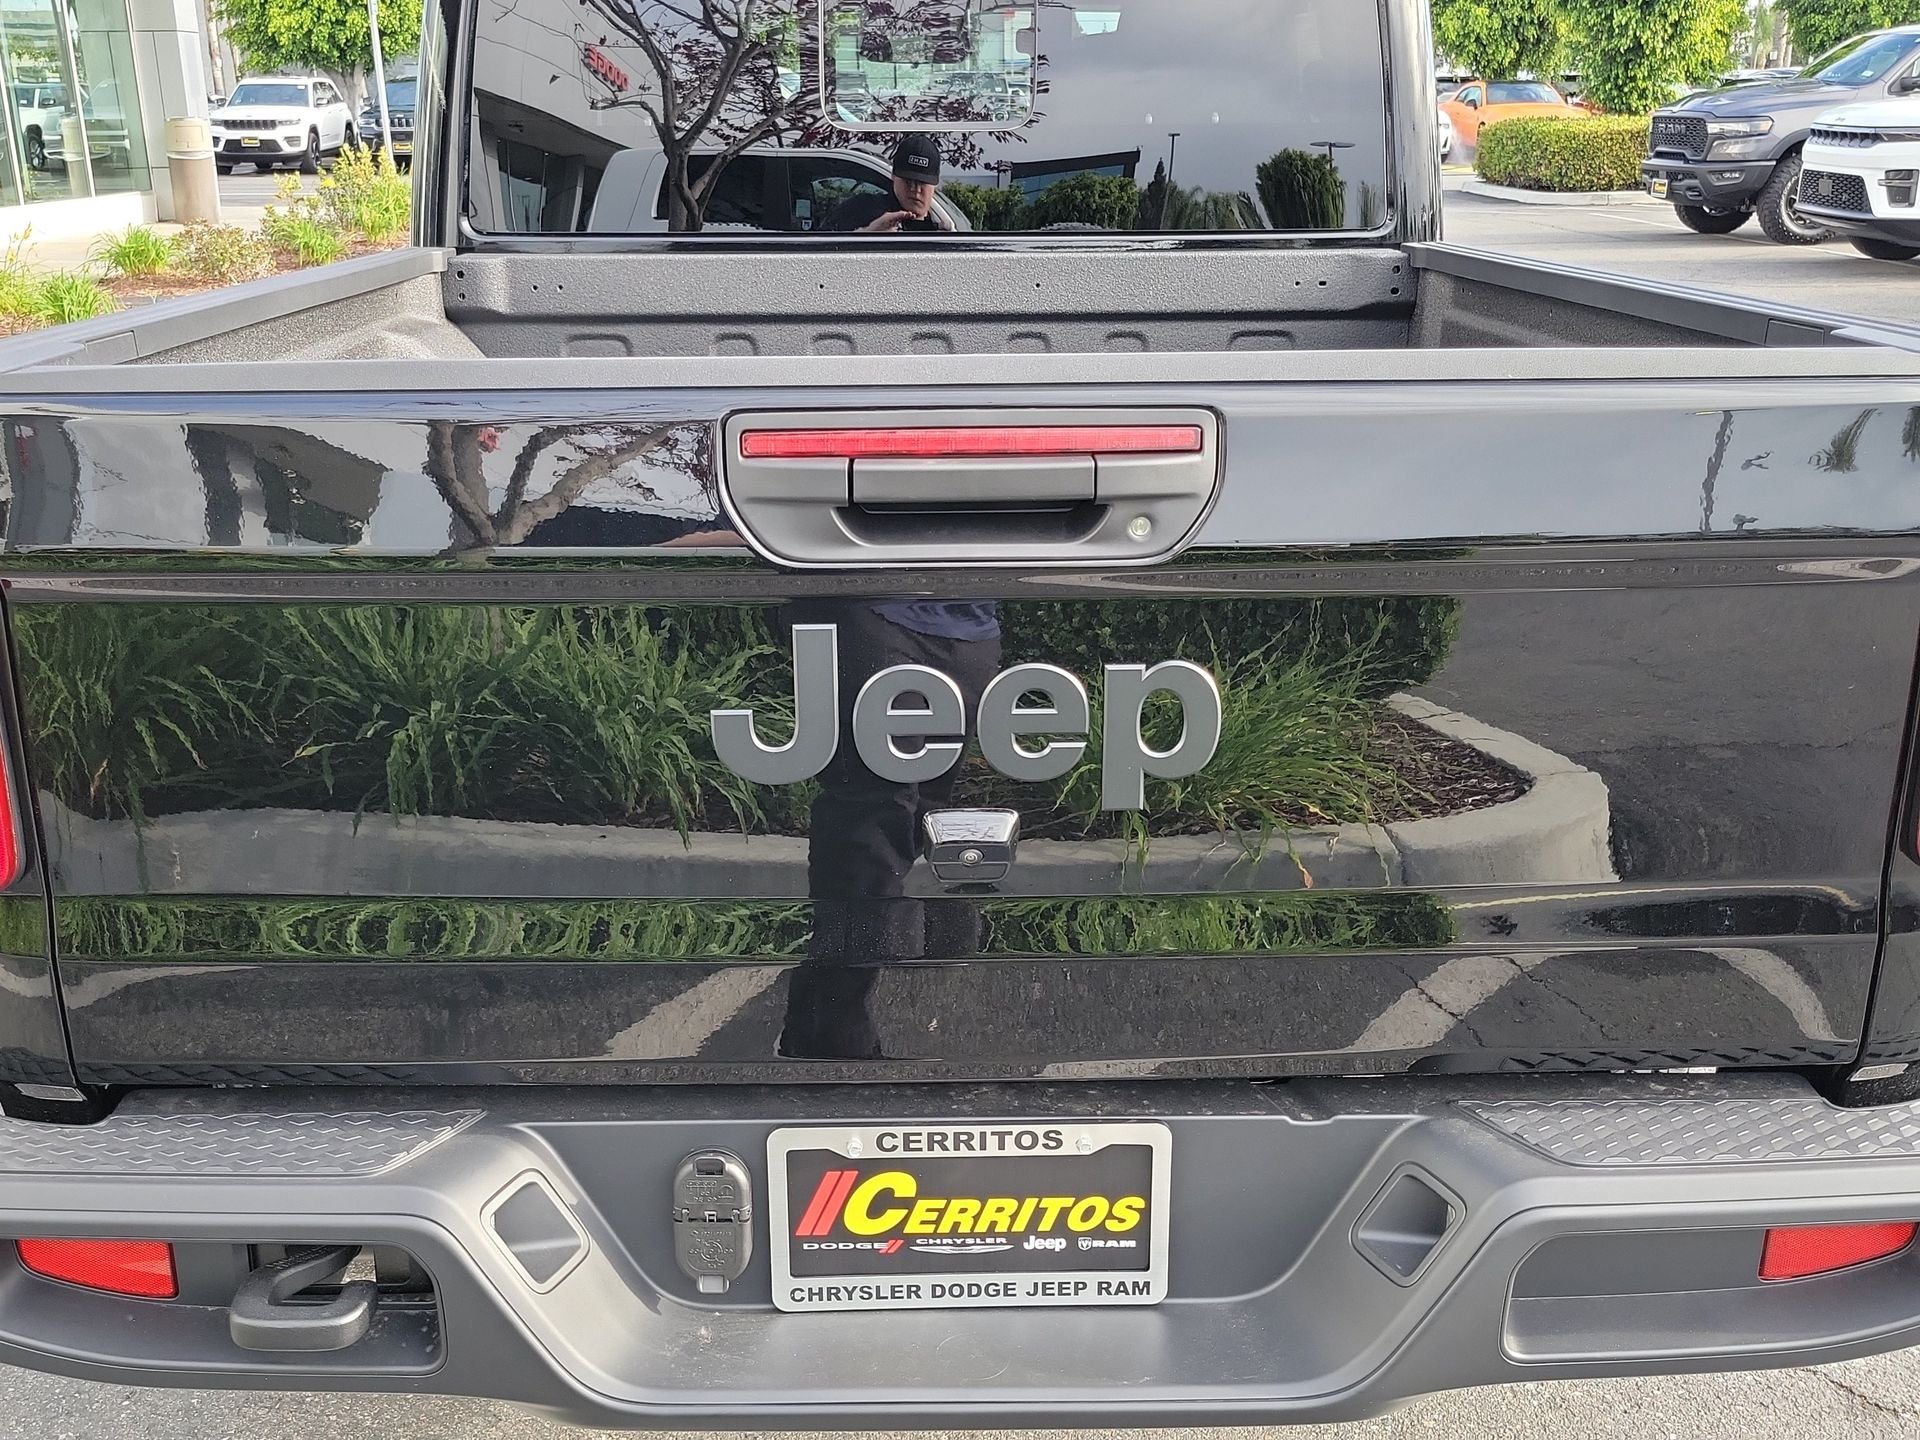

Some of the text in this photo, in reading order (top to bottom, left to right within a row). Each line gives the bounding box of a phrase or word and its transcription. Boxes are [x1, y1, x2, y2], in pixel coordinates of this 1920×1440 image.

[1658, 123, 1686, 134] RAM
[711, 624, 1222, 810] Jeep
[876, 1129, 1064, 1152] CERRITOS
[843, 1171, 1145, 1236] CERRITOS
[802, 1241, 889, 1250] DODGE
[915, 1237, 1008, 1245] CHRYSLER
[1023, 1235, 1067, 1252] Jeep
[1092, 1239, 1137, 1248] RAM
[789, 1280, 1151, 1303] CHRYSLER DODGE JEEP RAM
